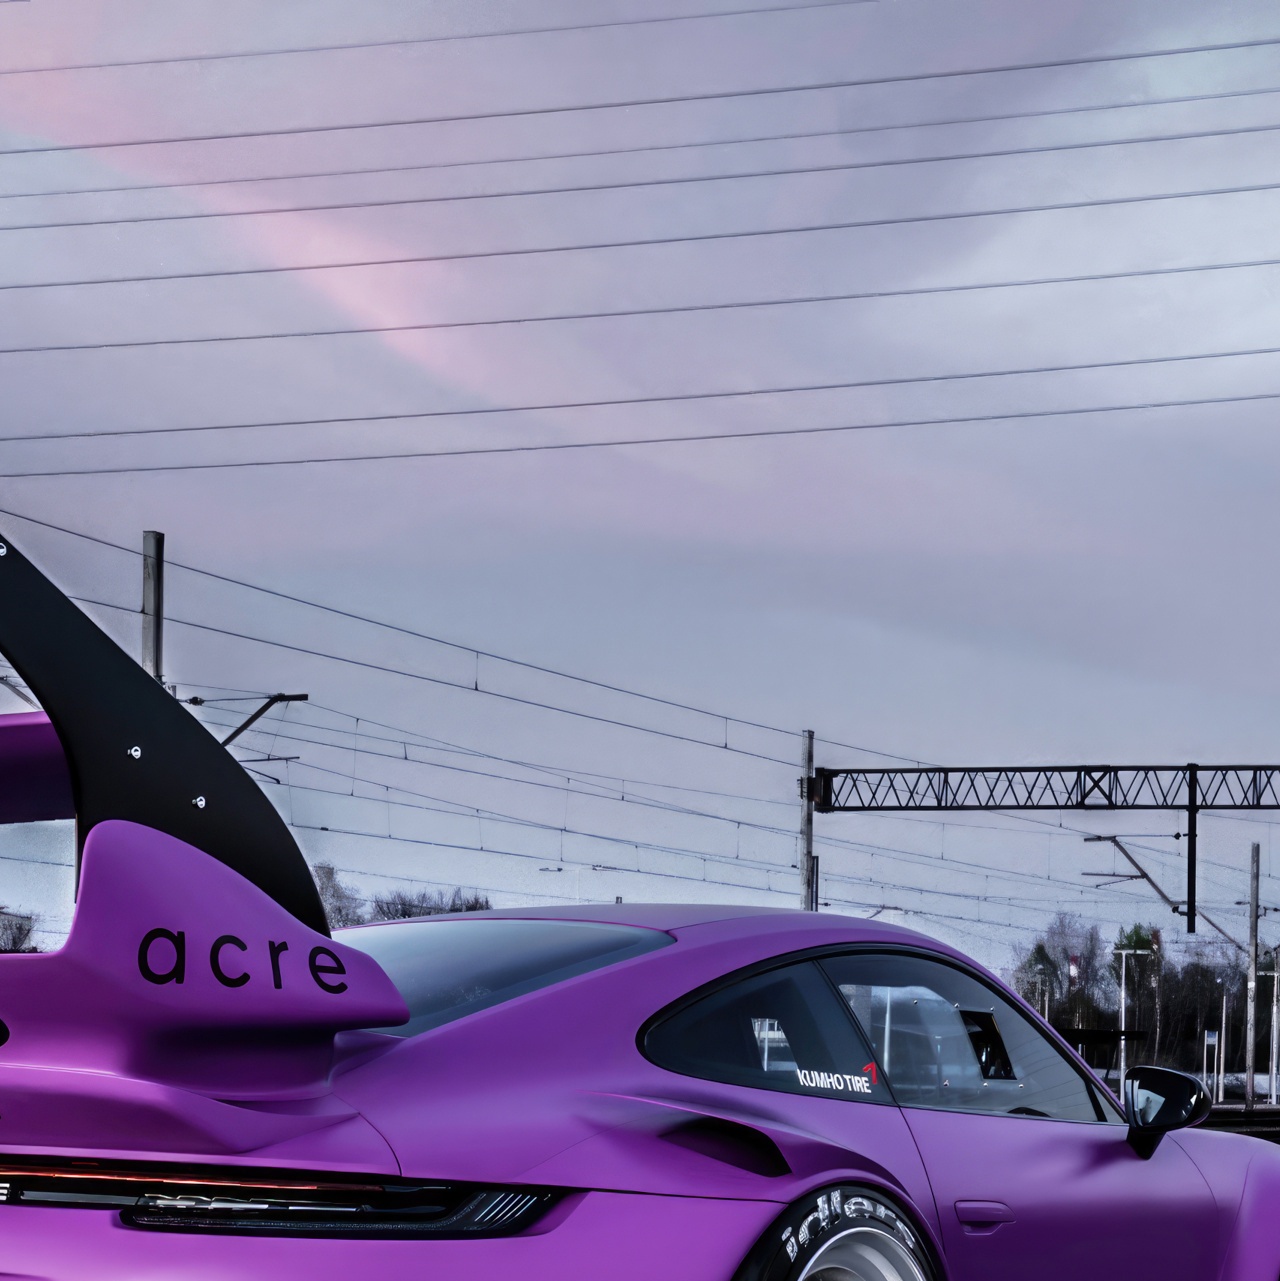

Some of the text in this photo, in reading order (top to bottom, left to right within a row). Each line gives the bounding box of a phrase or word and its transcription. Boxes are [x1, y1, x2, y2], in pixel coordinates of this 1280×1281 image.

[137, 927, 349, 995] acre
[796, 1068, 872, 1094] KUMHO TIRE
